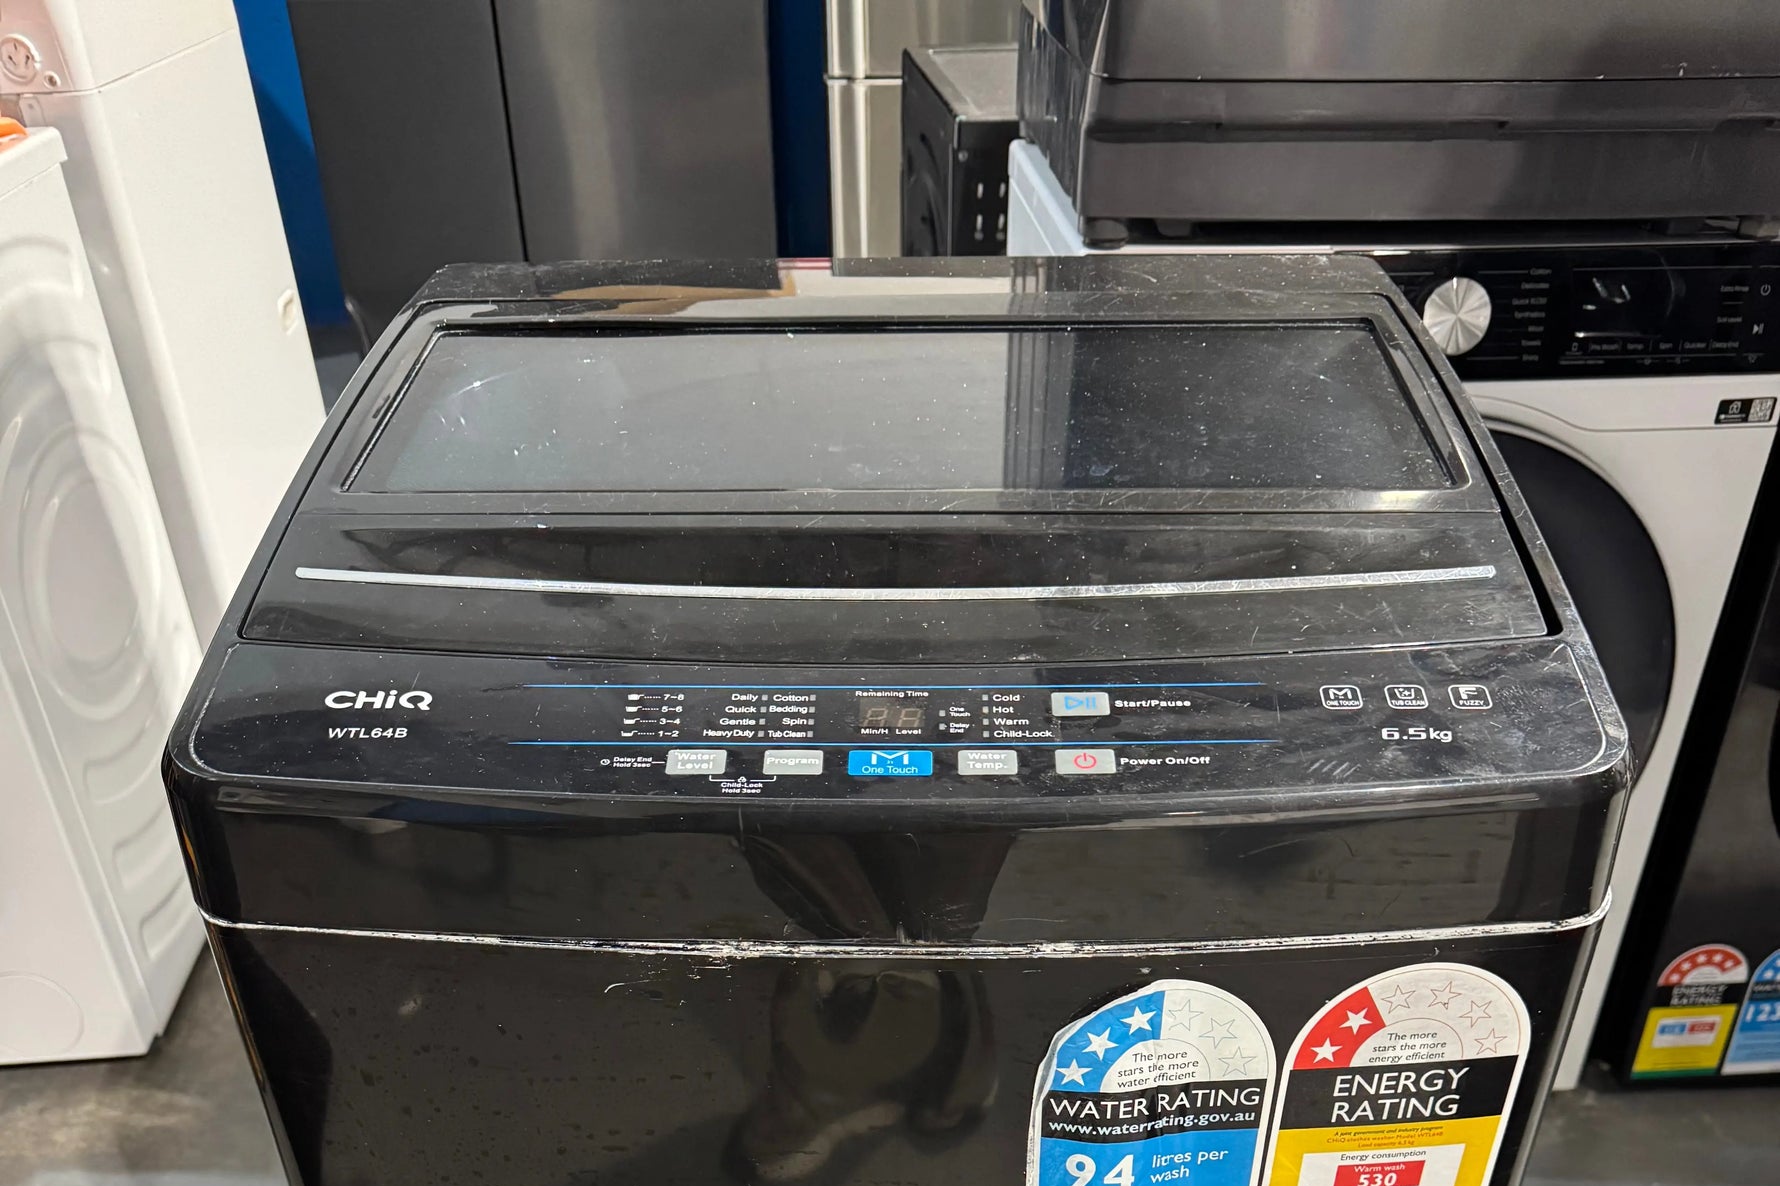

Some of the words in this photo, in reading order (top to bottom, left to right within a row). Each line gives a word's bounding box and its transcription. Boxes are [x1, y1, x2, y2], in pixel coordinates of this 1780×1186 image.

[731, 693, 759, 702] Daily
[773, 694, 809, 702] Cotton
[855, 690, 905, 698] Remaining
[992, 694, 1021, 702] Cold
[324, 689, 433, 711] CHiQ
[1114, 700, 1192, 708] Start/Pause
[725, 705, 757, 713] Quick
[769, 705, 808, 714] Bedding
[719, 717, 756, 725] Gentle
[782, 717, 807, 727] Spin
[328, 727, 409, 739] WTL64B
[703, 729, 733, 738] Heavy
[733, 729, 755, 738] Duty
[768, 730, 783, 738] Tub
[783, 730, 806, 738] Clean
[993, 730, 1053, 738] Child-Lock
[676, 752, 716, 760] Water
[1120, 757, 1163, 765] Power
[1165, 756, 1211, 765] On/Off
[677, 761, 713, 770] Level
[766, 757, 819, 766] Program
[967, 761, 1008, 770] Temp.
[861, 766, 884, 774] One
[886, 765, 918, 774] Touch
[1388, 1033, 1407, 1041] The
[1409, 1032, 1438, 1040] more
[1372, 1045, 1397, 1053] stars
[1400, 1043, 1417, 1051] the
[1420, 1042, 1447, 1050] more
[1132, 1053, 1154, 1063] The
[1157, 1050, 1188, 1060] more
[1368, 1055, 1402, 1064] energy
[1405, 1052, 1445, 1061] efficient
[1118, 1066, 1144, 1078] stars
[1148, 1063, 1165, 1073] the
[1168, 1060, 1199, 1071] more
[1117, 1078, 1150, 1088] water
[1333, 1067, 1470, 1097] ENERGY
[1050, 1098, 1150, 1120] WATER
[1157, 1087, 1261, 1113] RATING
[1331, 1094, 1460, 1123] RATING
[1049, 1112, 1255, 1136] www.waterrating.gov.au
[1152, 1151, 1192, 1168] litres
[1197, 1149, 1229, 1165] per
[1340, 1153, 1369, 1161] Energy
[1372, 1150, 1426, 1160] consumption
[1150, 1165, 1190, 1184] wash
